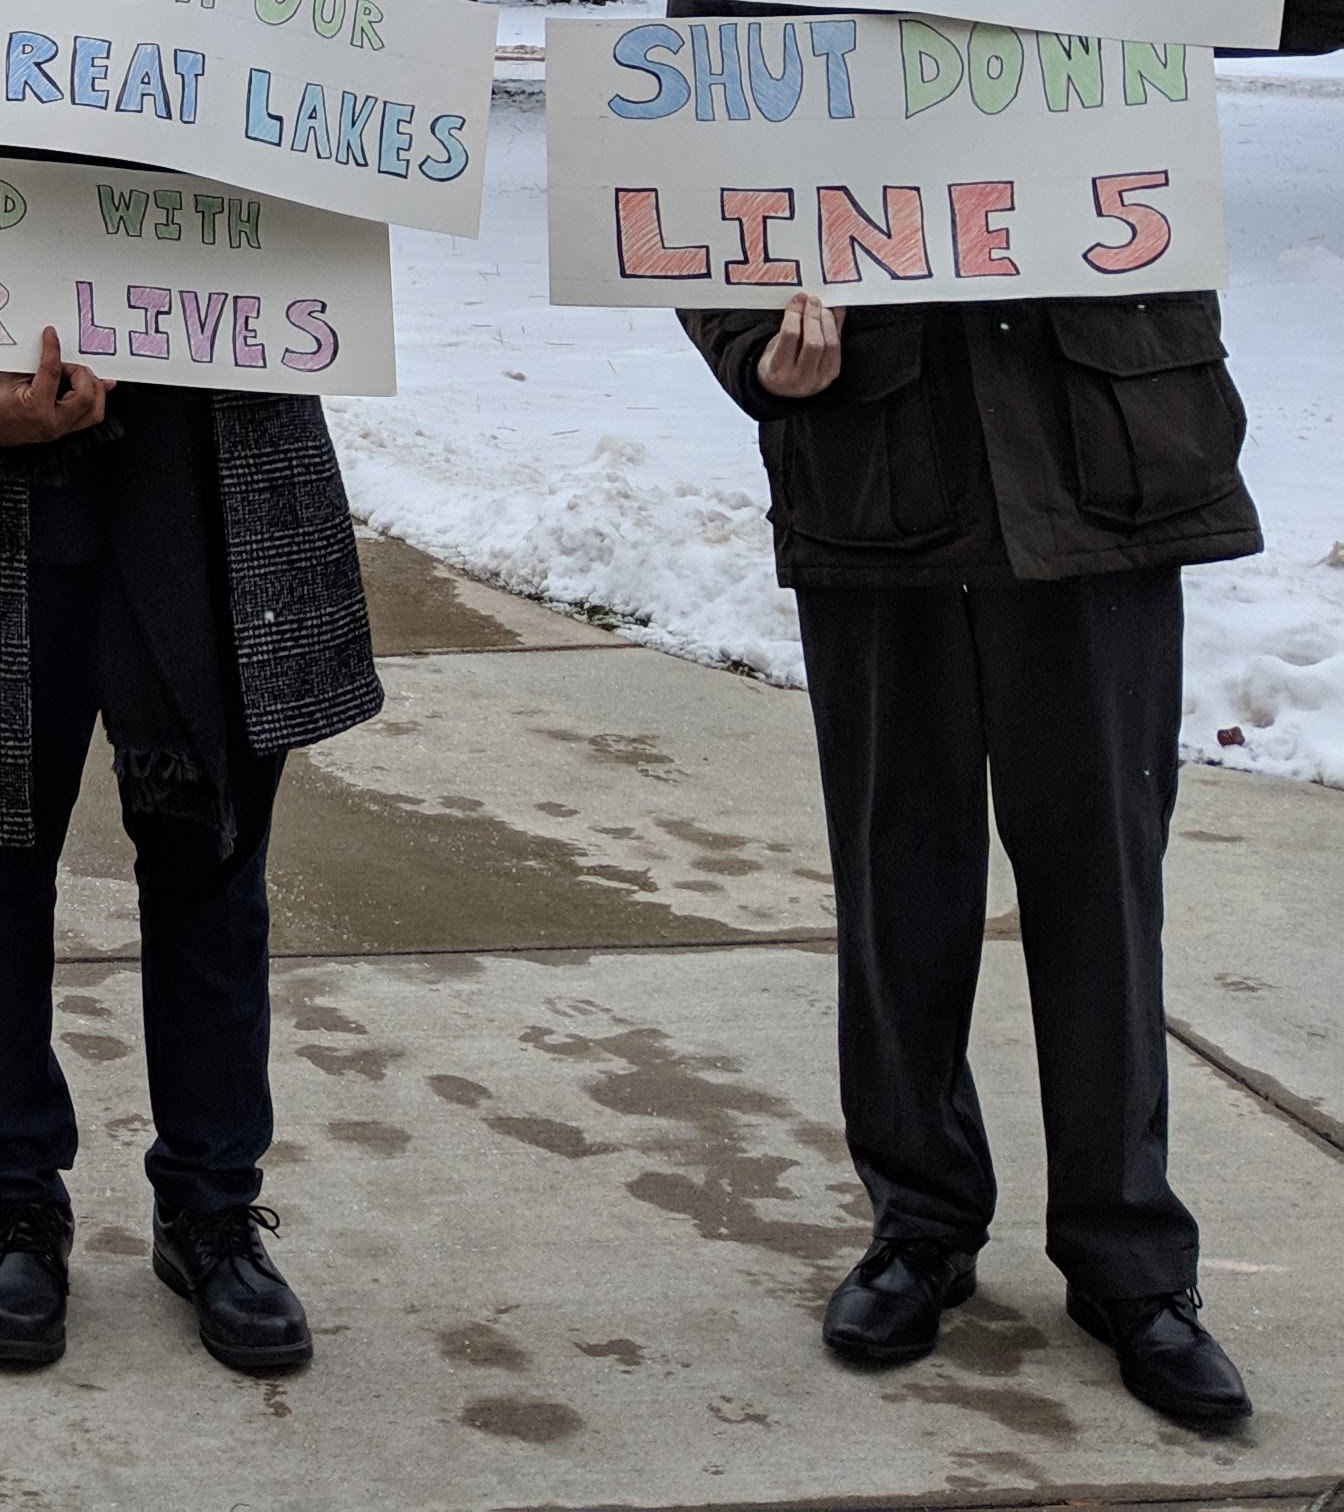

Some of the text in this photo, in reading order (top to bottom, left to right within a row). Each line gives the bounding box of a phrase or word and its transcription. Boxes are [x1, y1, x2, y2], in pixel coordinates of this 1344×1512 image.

[607, 19, 1188, 122] SHUT DOWN
[244, 68, 468, 182] LAKES
[96, 184, 261, 249] WITH
[615, 170, 1171, 286] LINE 5
[75, 280, 339, 373] LIVES
